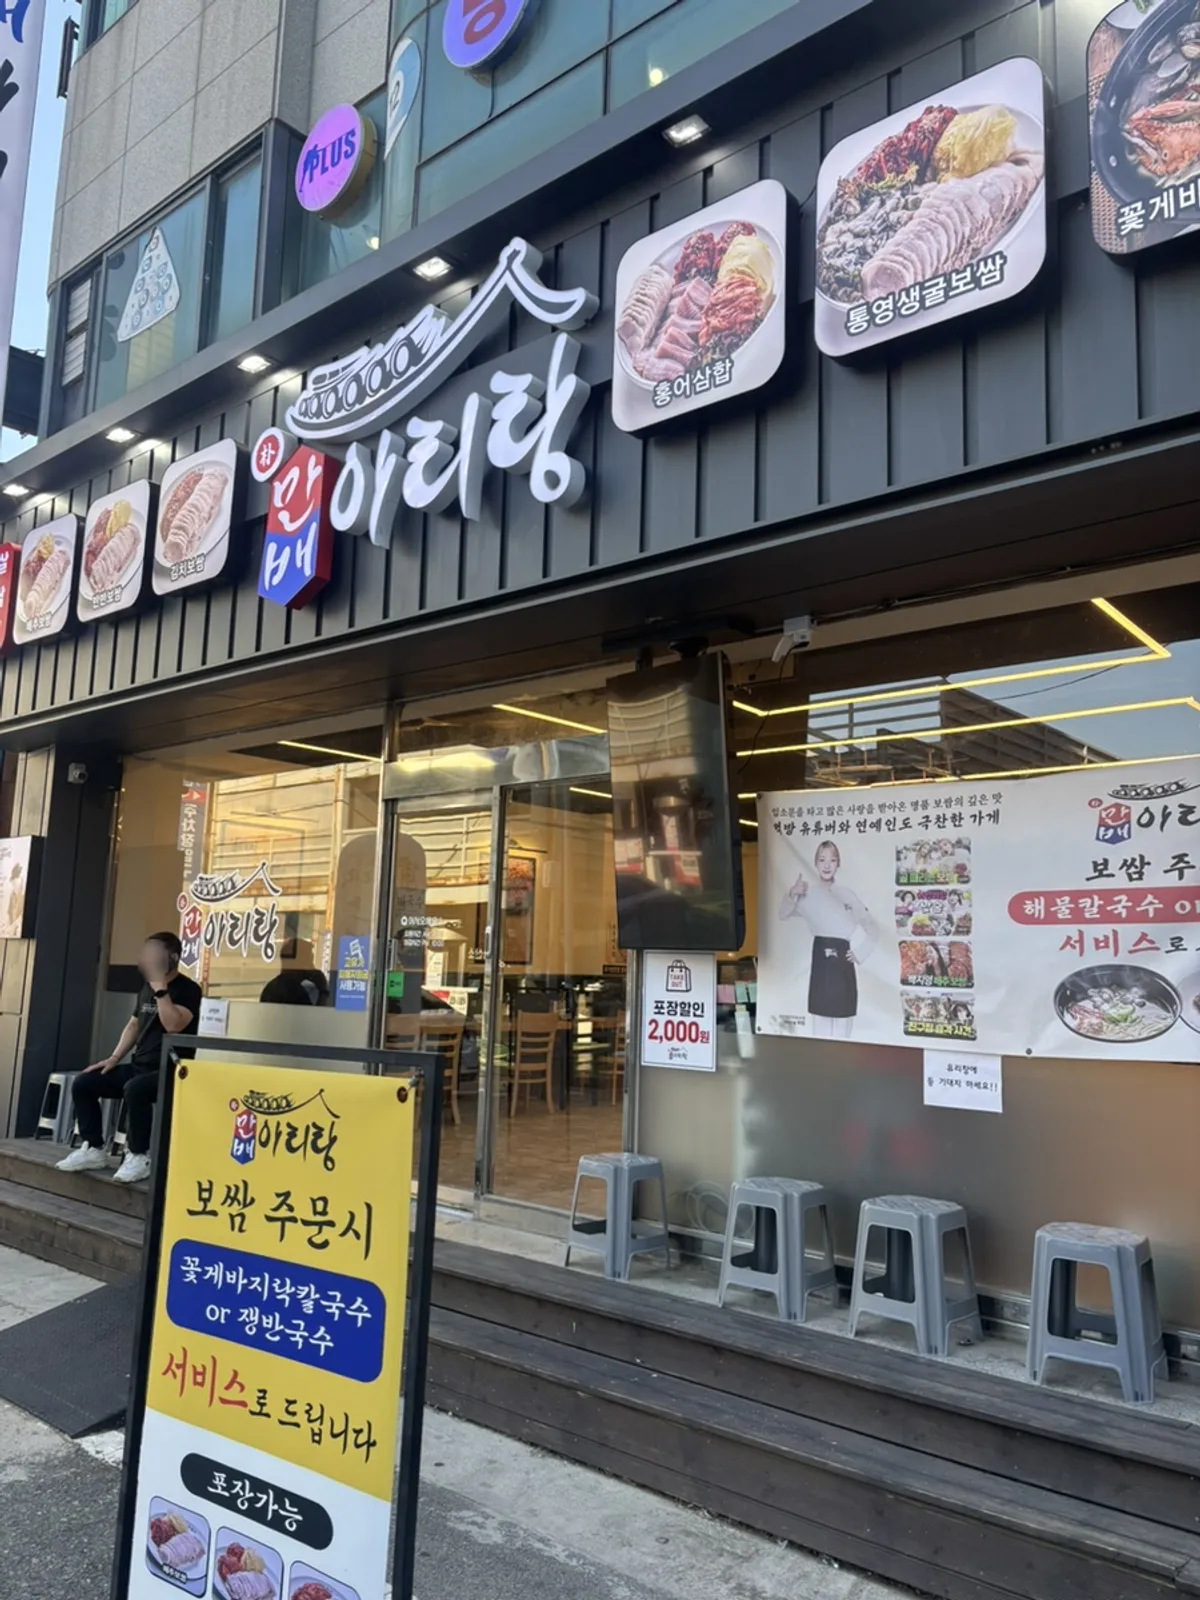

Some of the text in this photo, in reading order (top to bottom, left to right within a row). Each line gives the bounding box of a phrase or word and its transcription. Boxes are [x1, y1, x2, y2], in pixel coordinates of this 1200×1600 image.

[307, 127, 357, 184] PLUS
[846, 251, 1006, 335] 통영생굴보쌈
[654, 359, 732, 406] 홍어삼합
[264, 334, 578, 590] 만배 아리랑
[170, 555, 205, 581] 김치보쌈
[772, 793, 1003, 817] 입소문을 타고 많은 사랑을 받아온 명품 보쌈의 깊은 맛
[800, 819, 851, 836] 유튜버와
[856, 816, 912, 833] 연예인도
[918, 812, 964, 830] 극찬한
[970, 809, 1000, 826] 가게
[1101, 807, 1130, 840] 만배
[1085, 854, 1151, 882] 보쌈
[1022, 894, 1164, 920] 해물칼국수
[203, 902, 278, 961] 아리랑
[648, 1019, 710, 1044] 2,000원
[653, 1000, 704, 1018] 포장할인
[947, 1063, 977, 1075] 유리창에
[966, 1080, 998, 1092] 마세요!!
[233, 1113, 338, 1171] 만배 아리랑
[186, 1179, 373, 1260] 보쌈 주문시
[180, 1256, 372, 1327] 꽃게바지락칼국수
[206, 1305, 334, 1356] or 쟁반국수
[162, 1346, 377, 1463] 서비스로 드립니다
[207, 1471, 303, 1532] 포장가능
